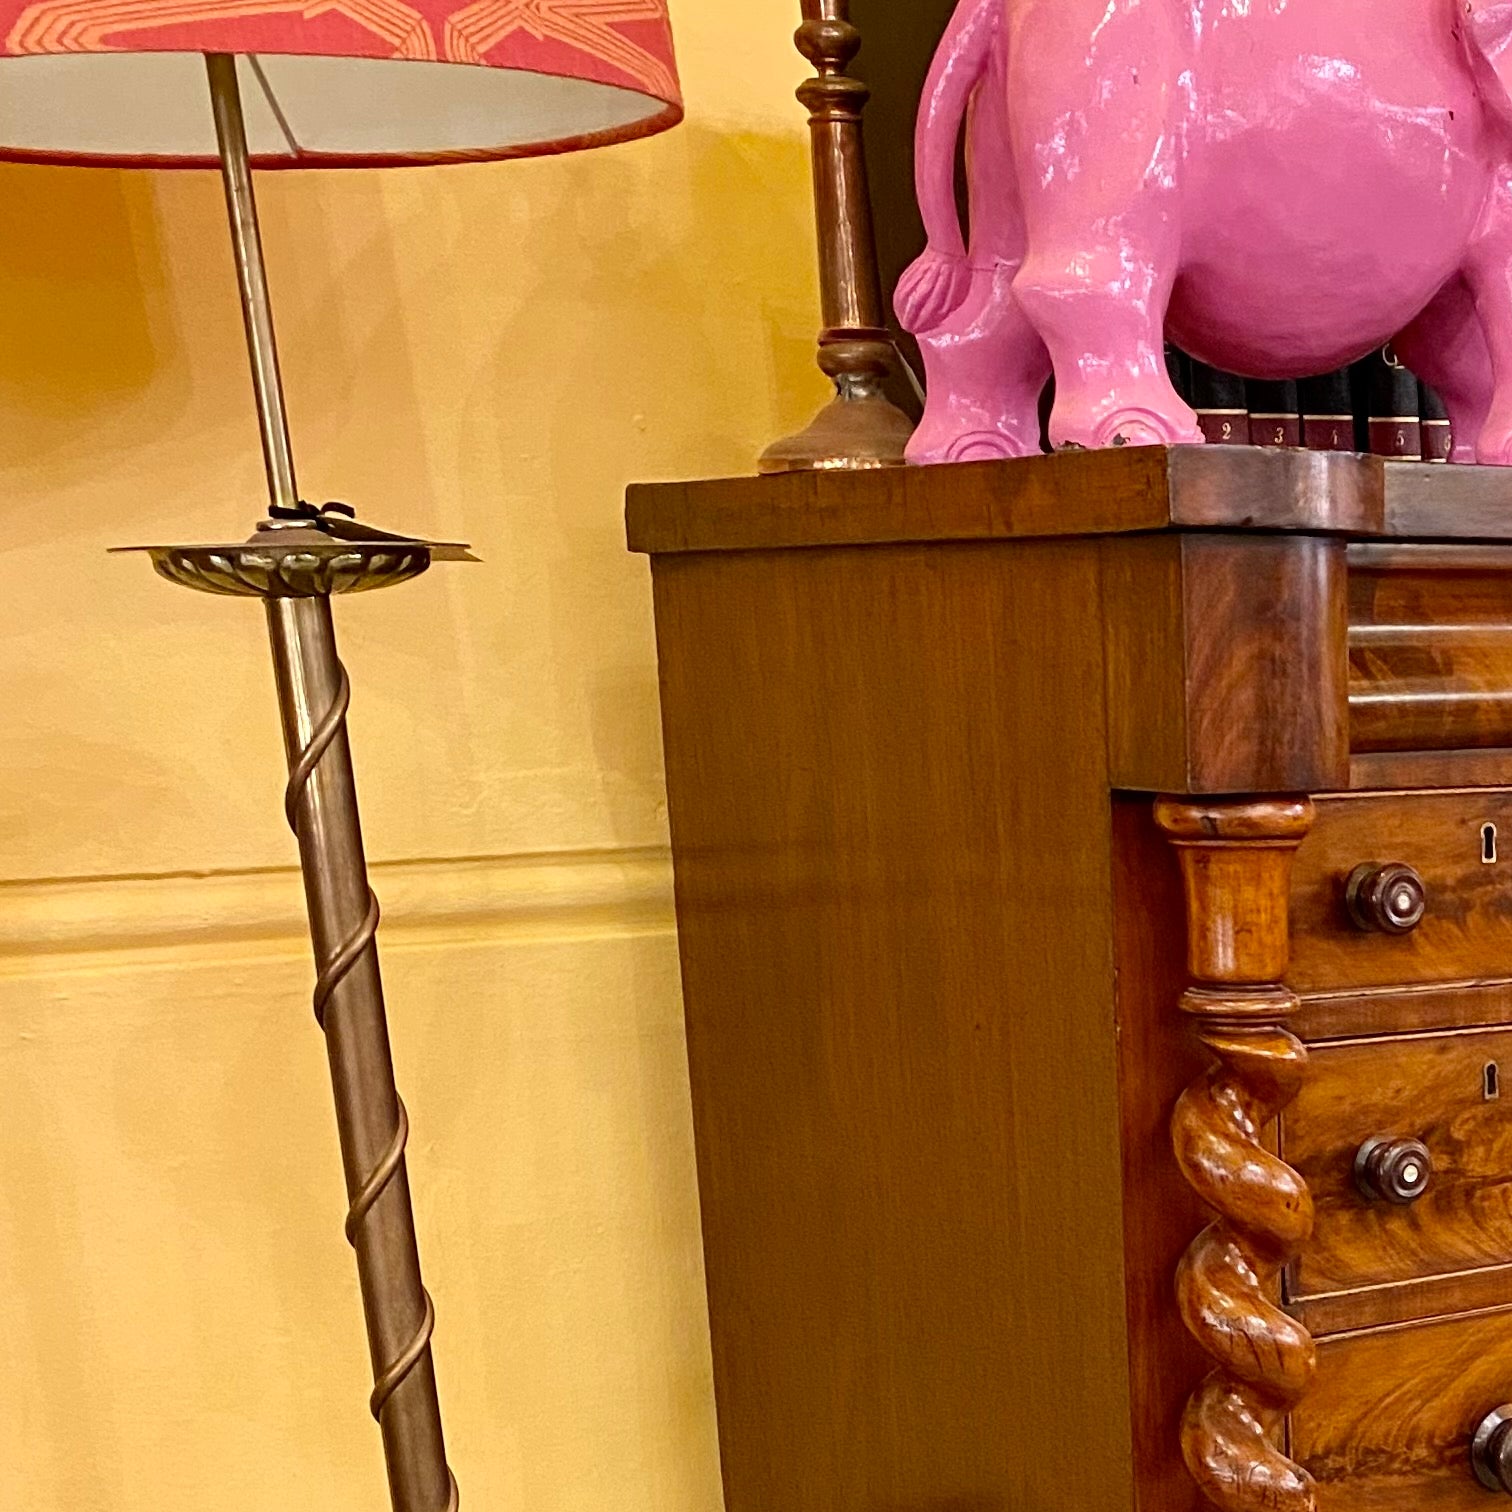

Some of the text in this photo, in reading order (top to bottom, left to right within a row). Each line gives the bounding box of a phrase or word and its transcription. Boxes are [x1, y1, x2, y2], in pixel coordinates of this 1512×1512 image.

[1222, 422, 1231, 439] 2
[1274, 427, 1284, 444] 3
[1396, 430, 1405, 446] 5
